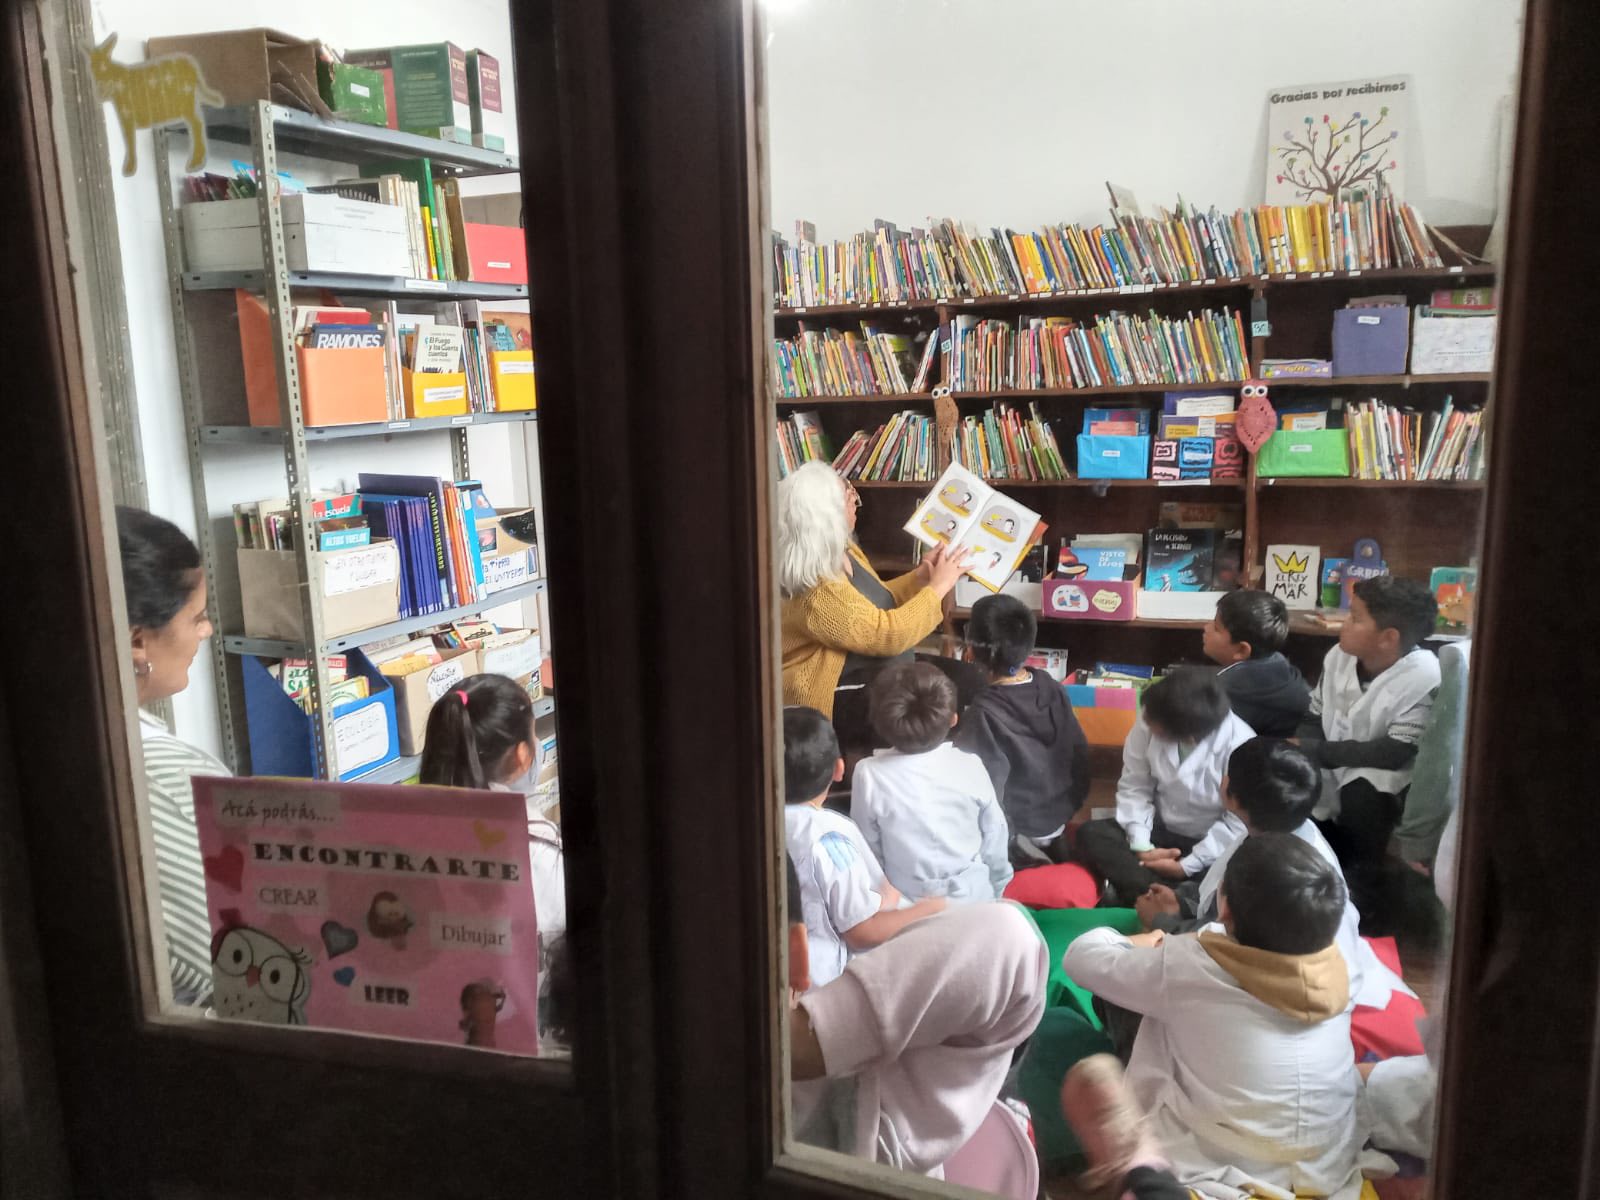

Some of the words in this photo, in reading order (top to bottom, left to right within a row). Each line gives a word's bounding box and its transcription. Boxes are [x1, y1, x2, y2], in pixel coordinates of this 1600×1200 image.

[1271, 90, 1318, 104] Gracias
[1323, 89, 1343, 101] por
[1346, 82, 1406, 96] recibirnos
[317, 333, 381, 349] RAMONES
[1272, 583, 1308, 600] MAR
[222, 799, 258, 817] Acá
[253, 842, 520, 881] ENCONTRARTE
[259, 887, 318, 906] CREAR
[441, 925, 506, 948] Dibujar
[364, 984, 410, 1006] LEER
